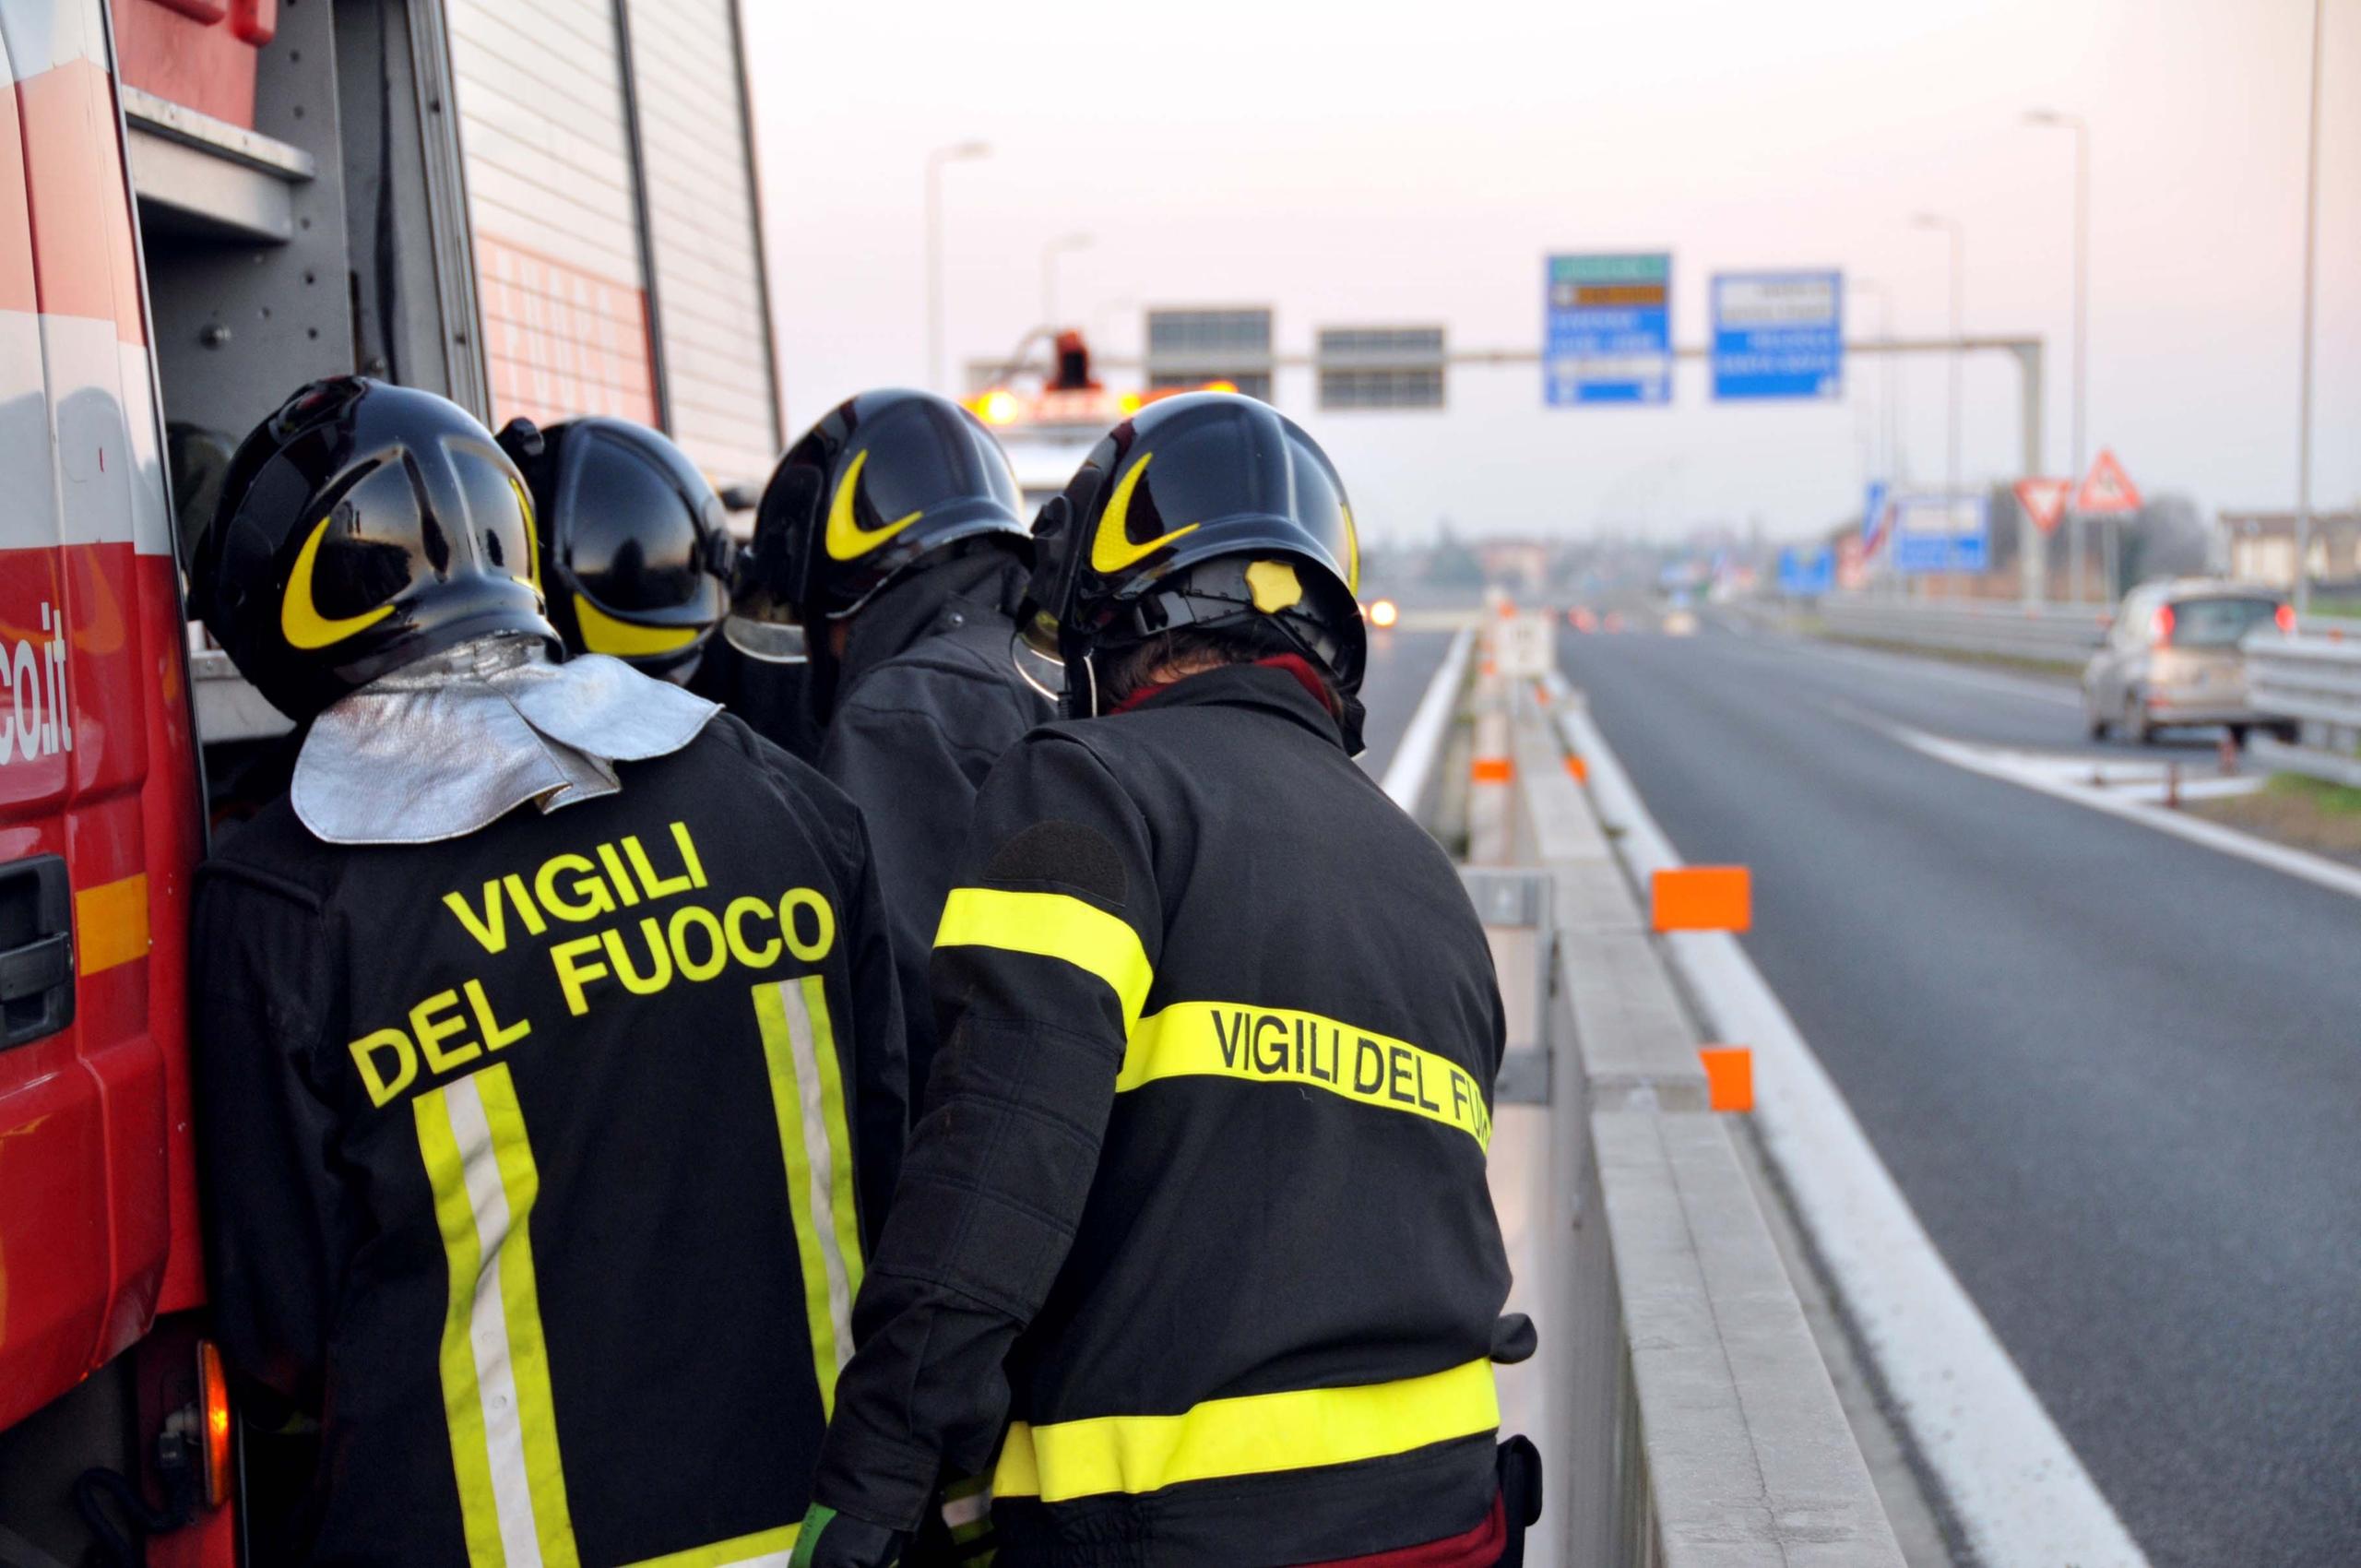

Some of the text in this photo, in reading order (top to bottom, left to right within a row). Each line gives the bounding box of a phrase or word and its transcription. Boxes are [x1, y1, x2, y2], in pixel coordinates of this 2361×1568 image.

[442, 821, 709, 955] VIGILI
[348, 886, 836, 1109] DEL FUOCO
[1210, 1009, 1340, 1085] VIGILI
[1353, 1036, 1441, 1112] DEL
